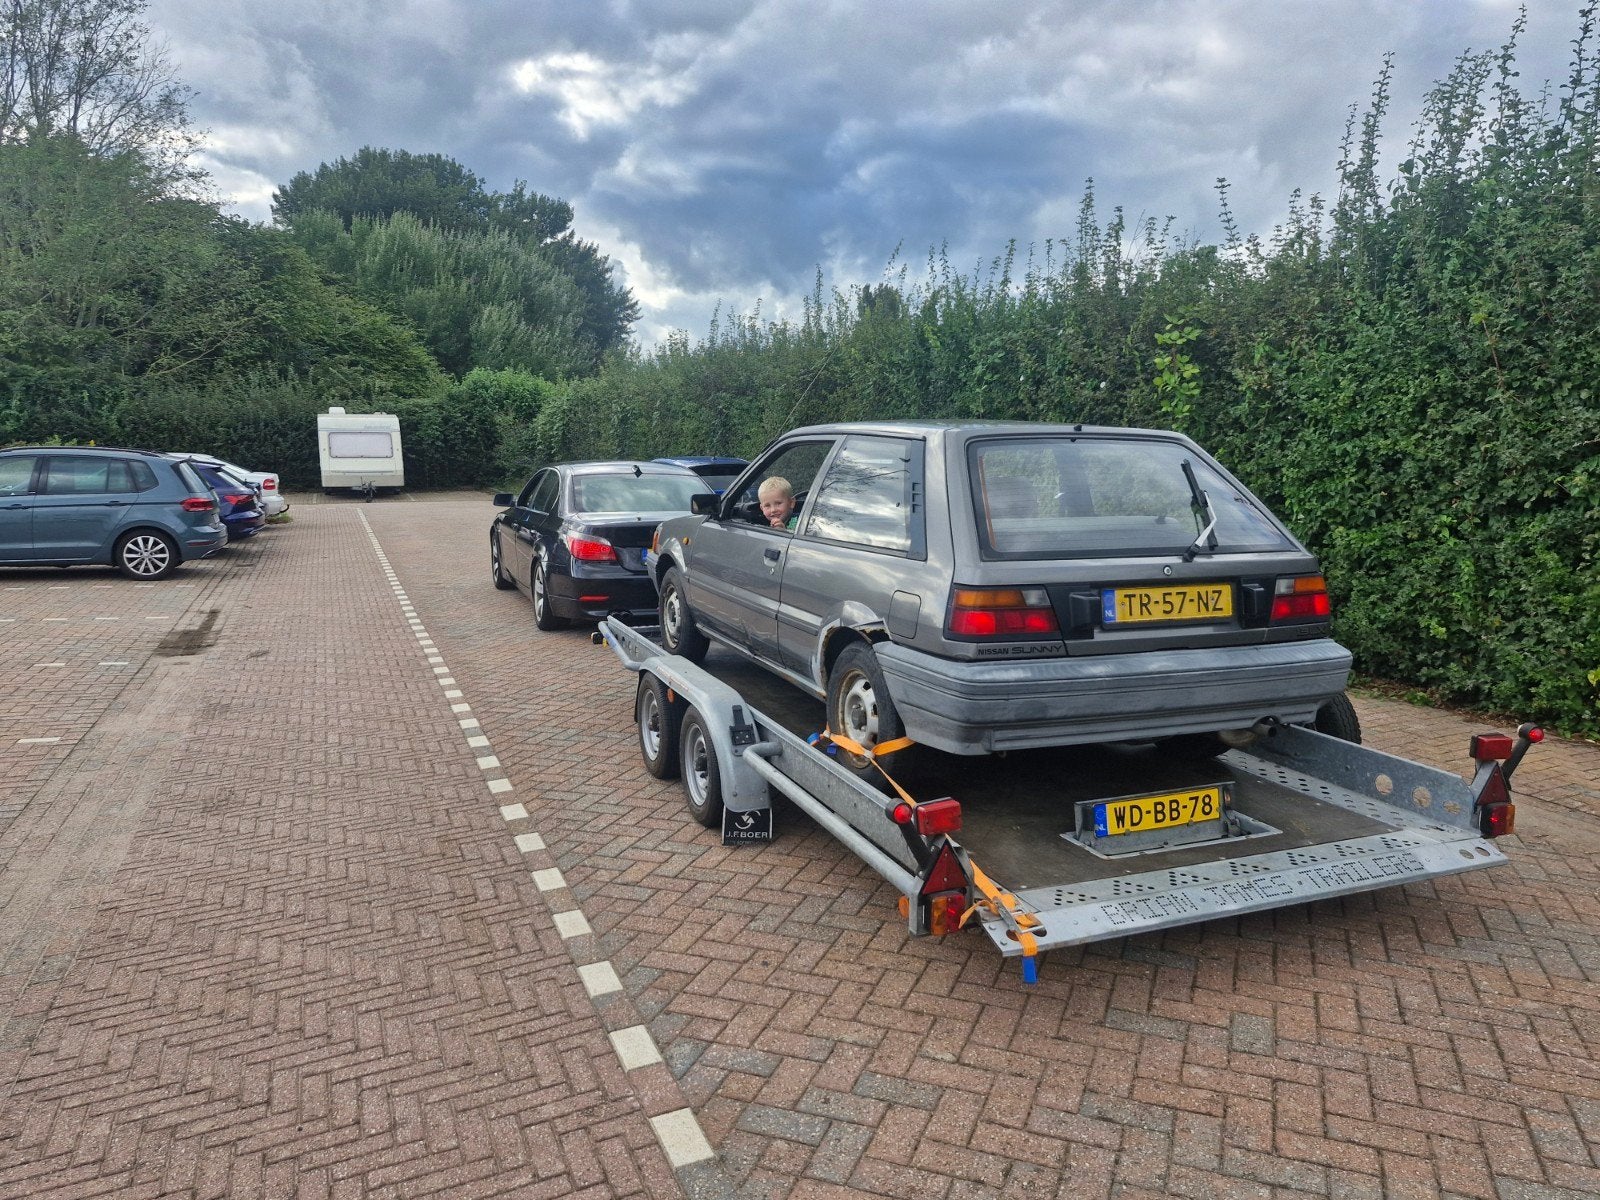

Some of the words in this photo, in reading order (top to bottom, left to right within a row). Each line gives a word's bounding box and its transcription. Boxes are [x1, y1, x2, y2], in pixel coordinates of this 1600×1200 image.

[1123, 589, 1223, 617] TR-57-NZ
[977, 647, 1009, 656] NISSAN
[1011, 645, 1062, 654] SUNNY
[1113, 793, 1213, 829] WD-BB-78
[1101, 892, 1198, 925] BRIAN
[1204, 875, 1293, 906] JAMES
[1298, 852, 1425, 889] TRAILERS
